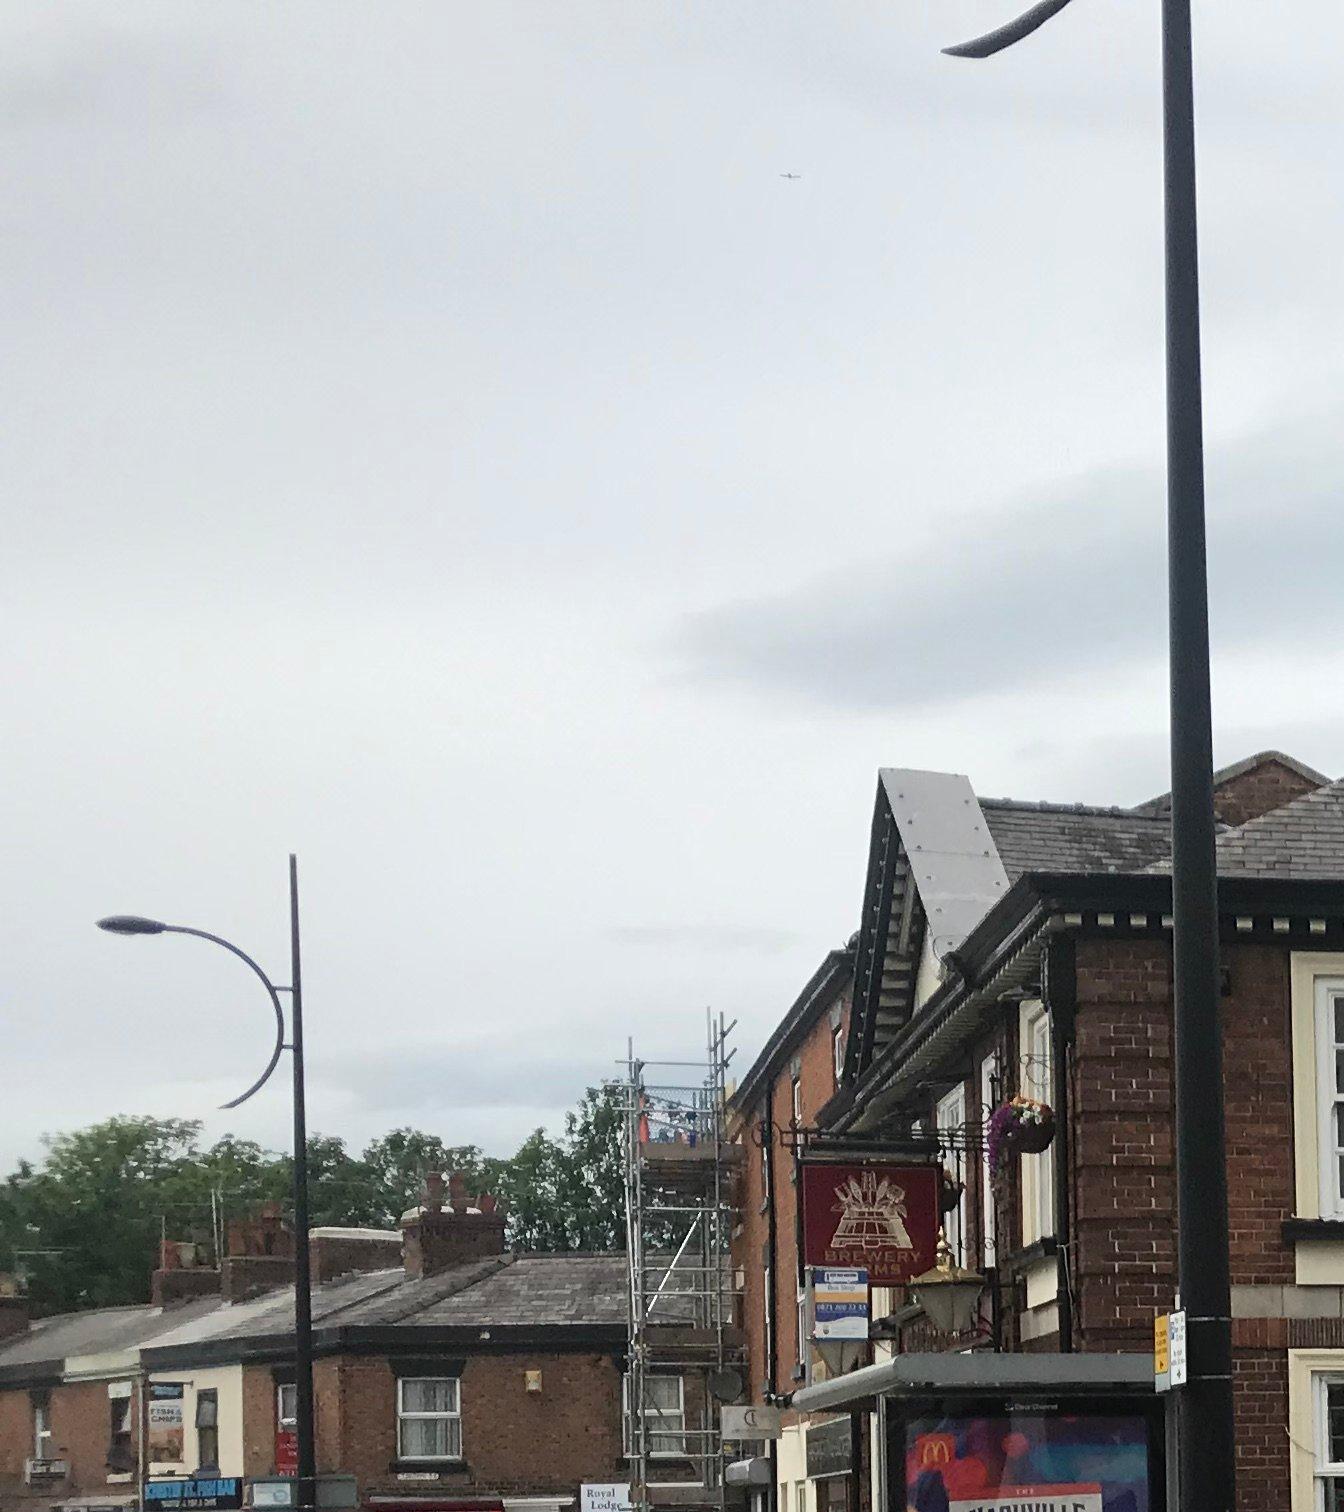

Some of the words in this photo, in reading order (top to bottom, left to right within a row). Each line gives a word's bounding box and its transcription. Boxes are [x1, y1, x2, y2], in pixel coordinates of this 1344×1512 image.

[824, 1250, 921, 1263] BREWERY
[587, 1488, 616, 1500] Royal
[1016, 1488, 1034, 1496] THE
[591, 1500, 623, 1512] Lodge
